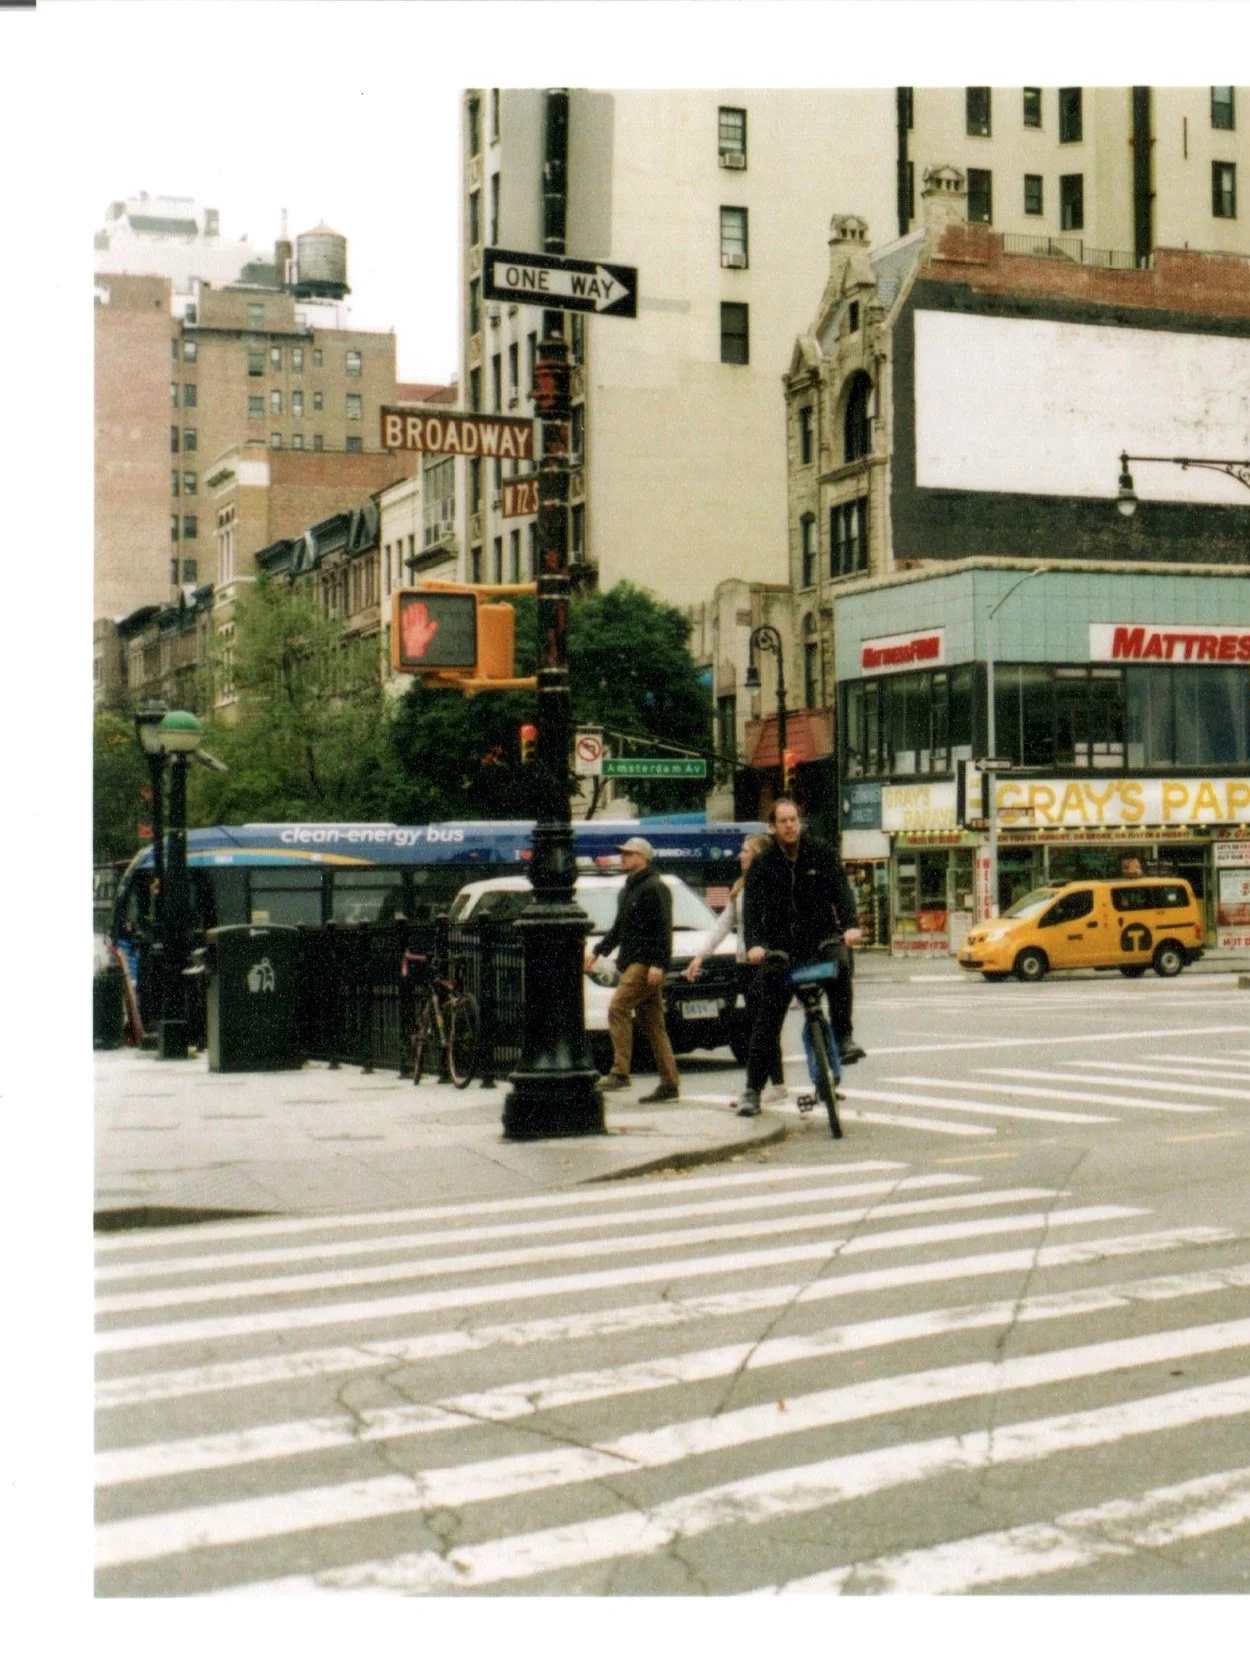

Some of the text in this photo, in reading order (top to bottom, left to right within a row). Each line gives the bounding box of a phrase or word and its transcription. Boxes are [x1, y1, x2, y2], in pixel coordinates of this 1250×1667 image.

[505, 267, 614, 299] ONE WAY
[385, 414, 530, 458] BROADWAY
[504, 480, 540, 516] W 72 S
[607, 763, 701, 773] Amsterdam Av
[996, 779, 1146, 823] GRAY'S
[280, 826, 465, 846] clean-energy bus
